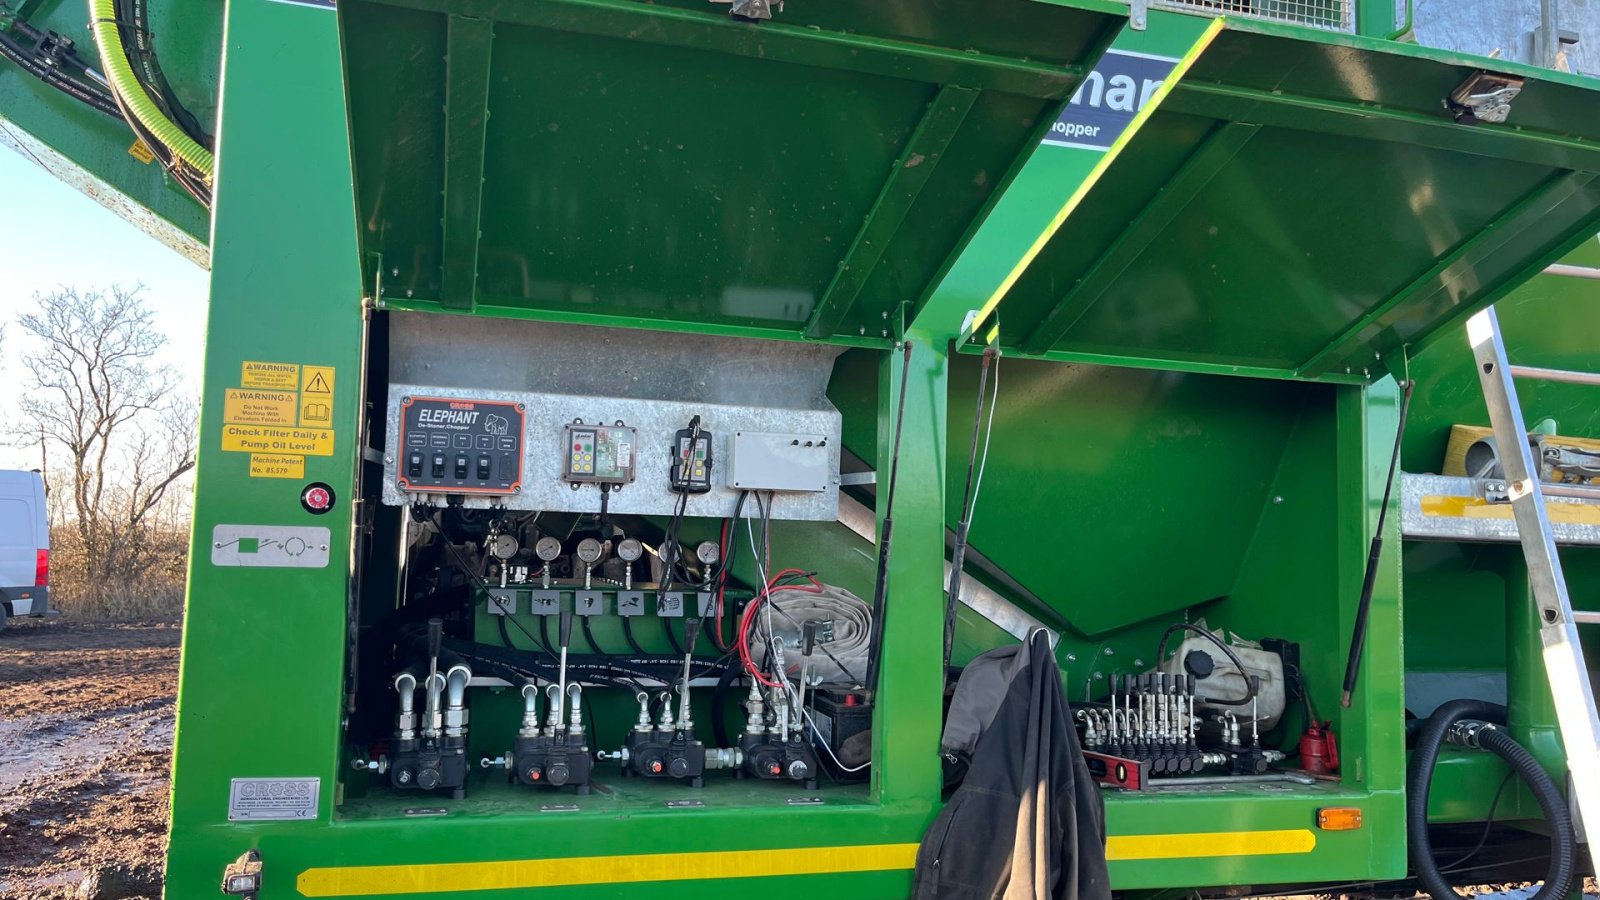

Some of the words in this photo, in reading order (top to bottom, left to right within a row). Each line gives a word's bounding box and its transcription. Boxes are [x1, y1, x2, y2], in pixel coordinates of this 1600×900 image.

[254, 364, 295, 372] WARNING
[240, 392, 284, 401] WARNING
[419, 409, 479, 424] ELEPHANT
[293, 431, 317, 440] Daily
[241, 440, 269, 449] Pump
[241, 783, 309, 796] CROSS
